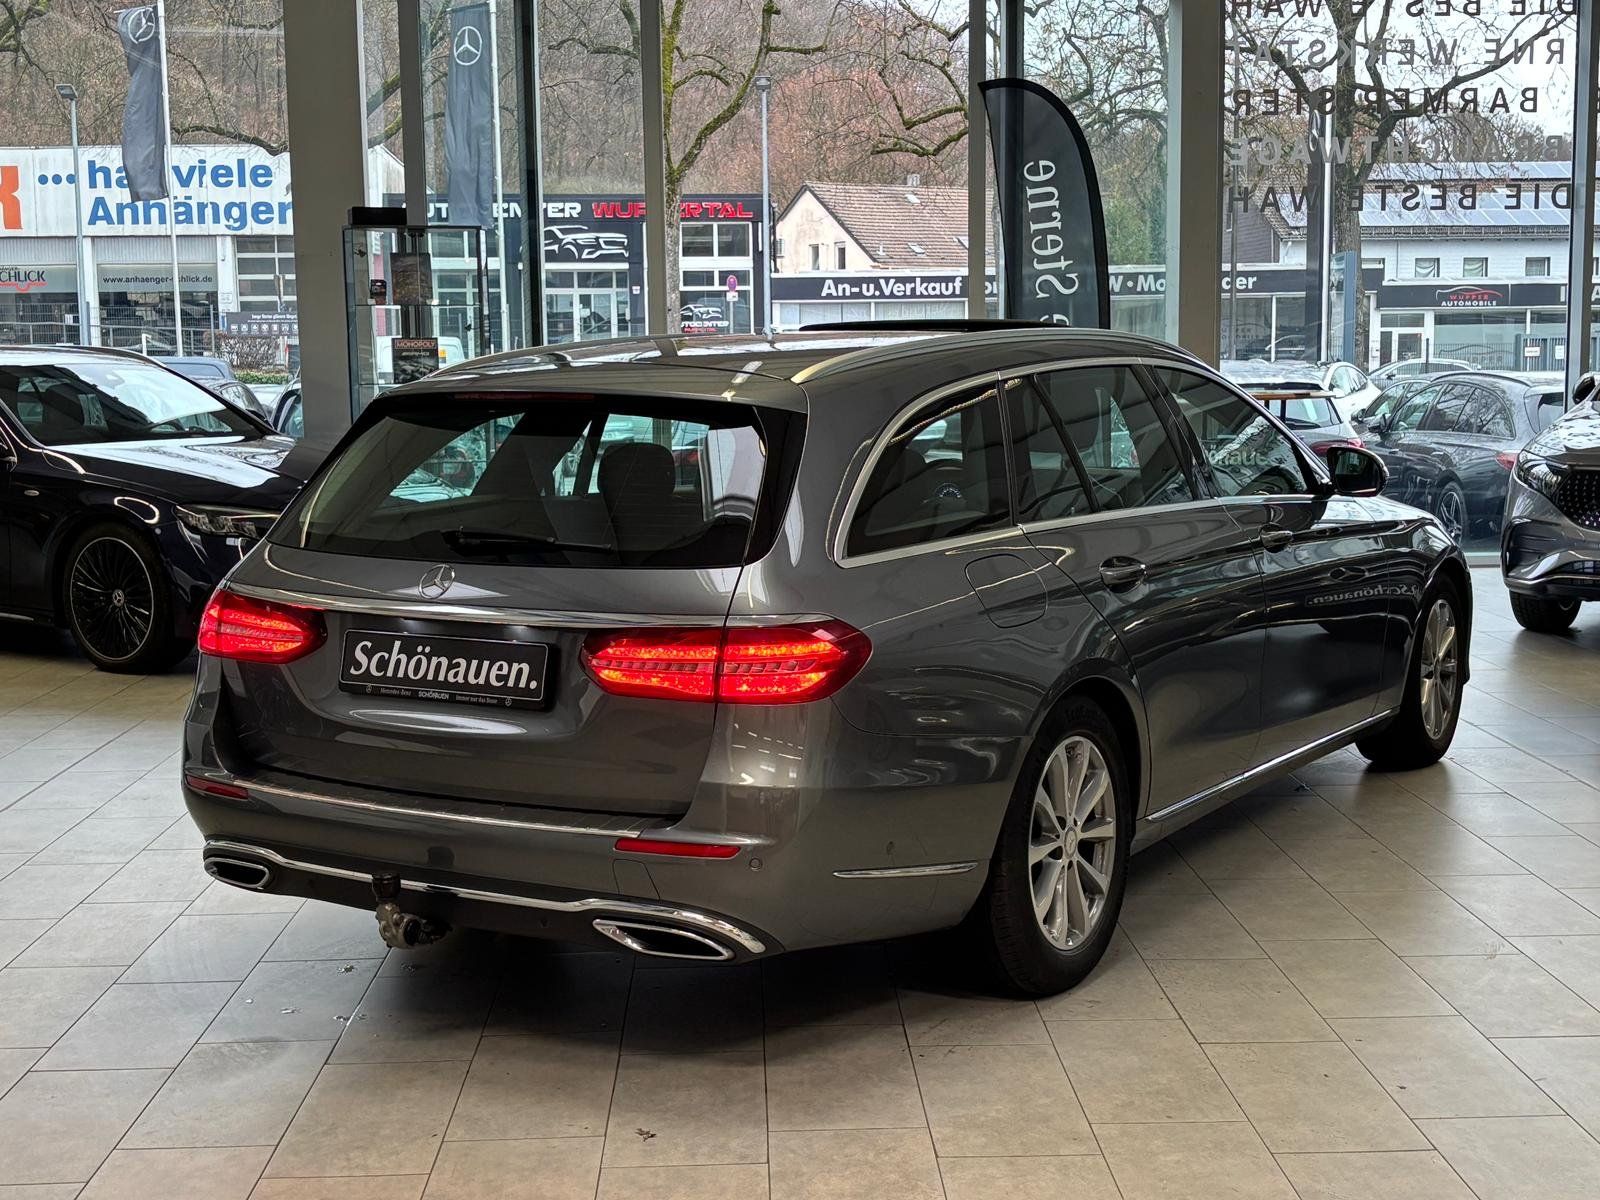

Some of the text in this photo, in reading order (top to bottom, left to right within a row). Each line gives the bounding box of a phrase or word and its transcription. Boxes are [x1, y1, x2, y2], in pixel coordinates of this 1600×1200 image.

[171, 158, 273, 189] viele
[0, 270, 46, 282] CHLICK
[396, 340, 436, 348] MONOPOLY
[349, 639, 538, 690] Schönauen.
